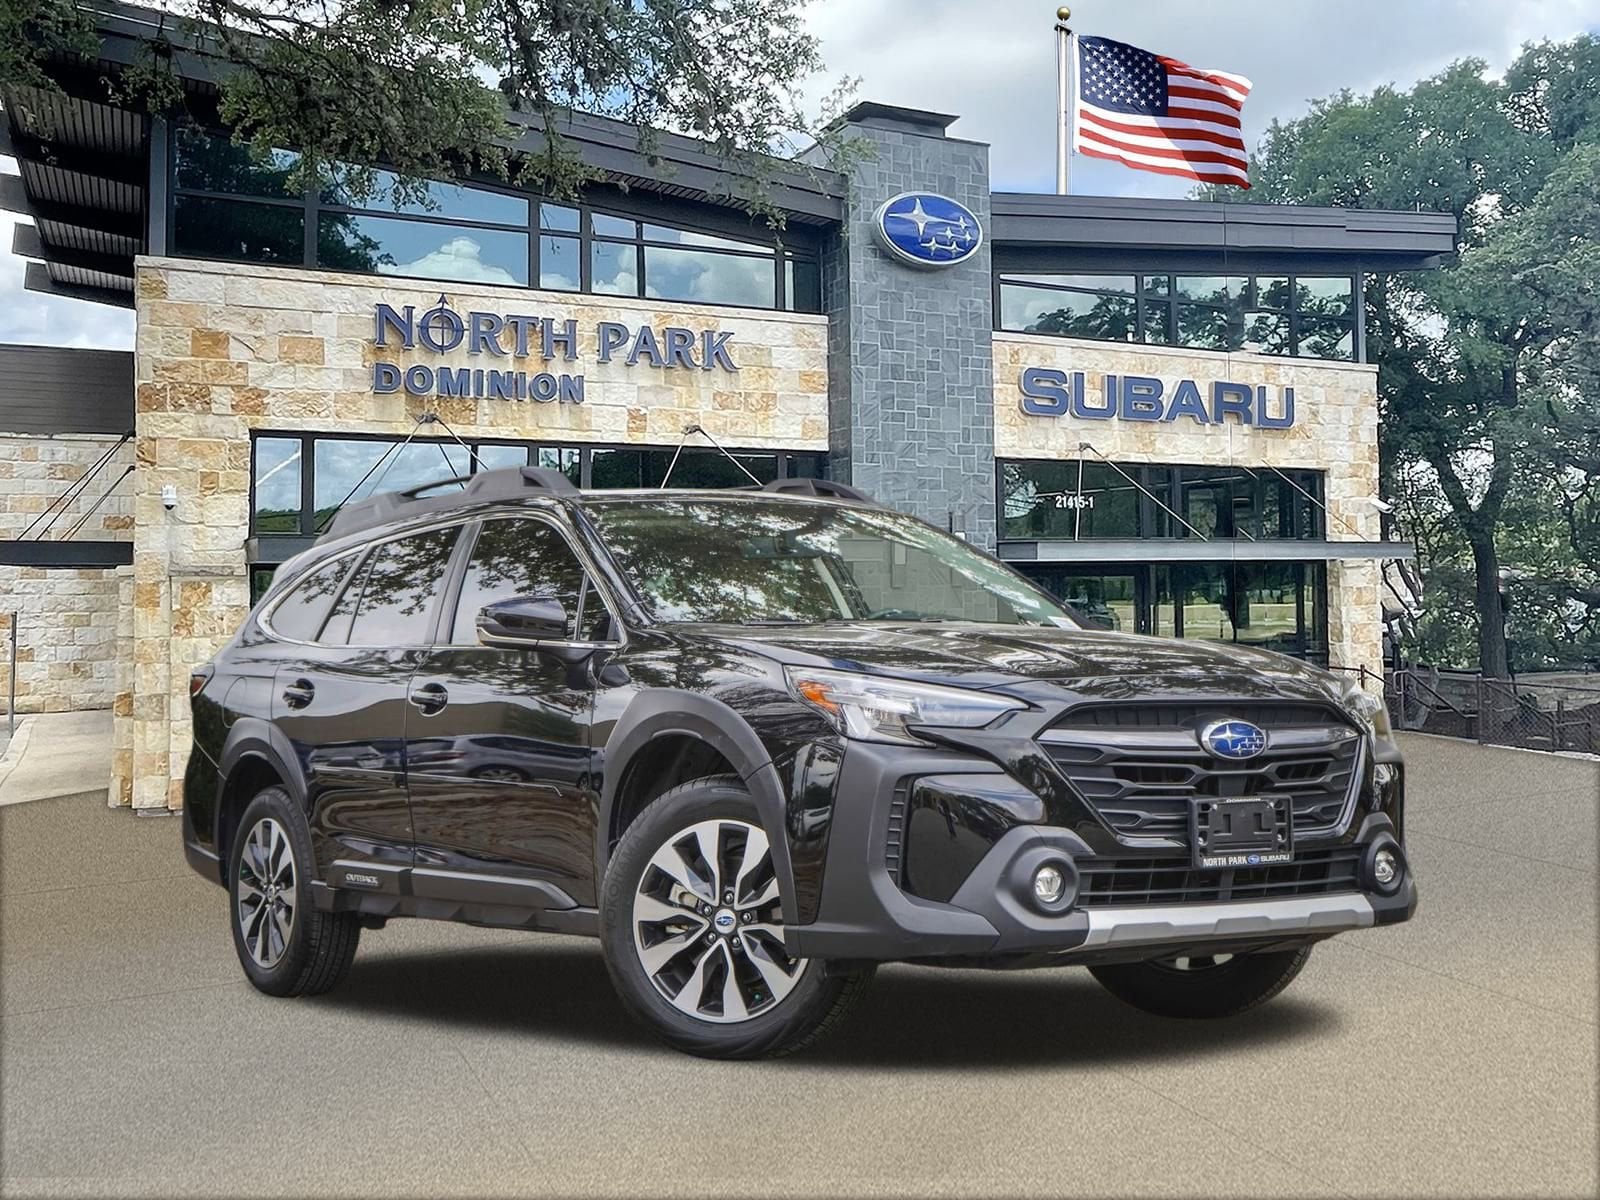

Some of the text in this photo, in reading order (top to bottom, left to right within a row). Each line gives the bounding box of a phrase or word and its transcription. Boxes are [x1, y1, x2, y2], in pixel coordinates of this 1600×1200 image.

[374, 300, 742, 373] NORTH PARK
[373, 361, 585, 404] DOMINION
[1018, 366, 1295, 430] SUBARU
[345, 873, 378, 885] OUTBACK
[1203, 854, 1290, 867] NORTH PARK SUBARU
